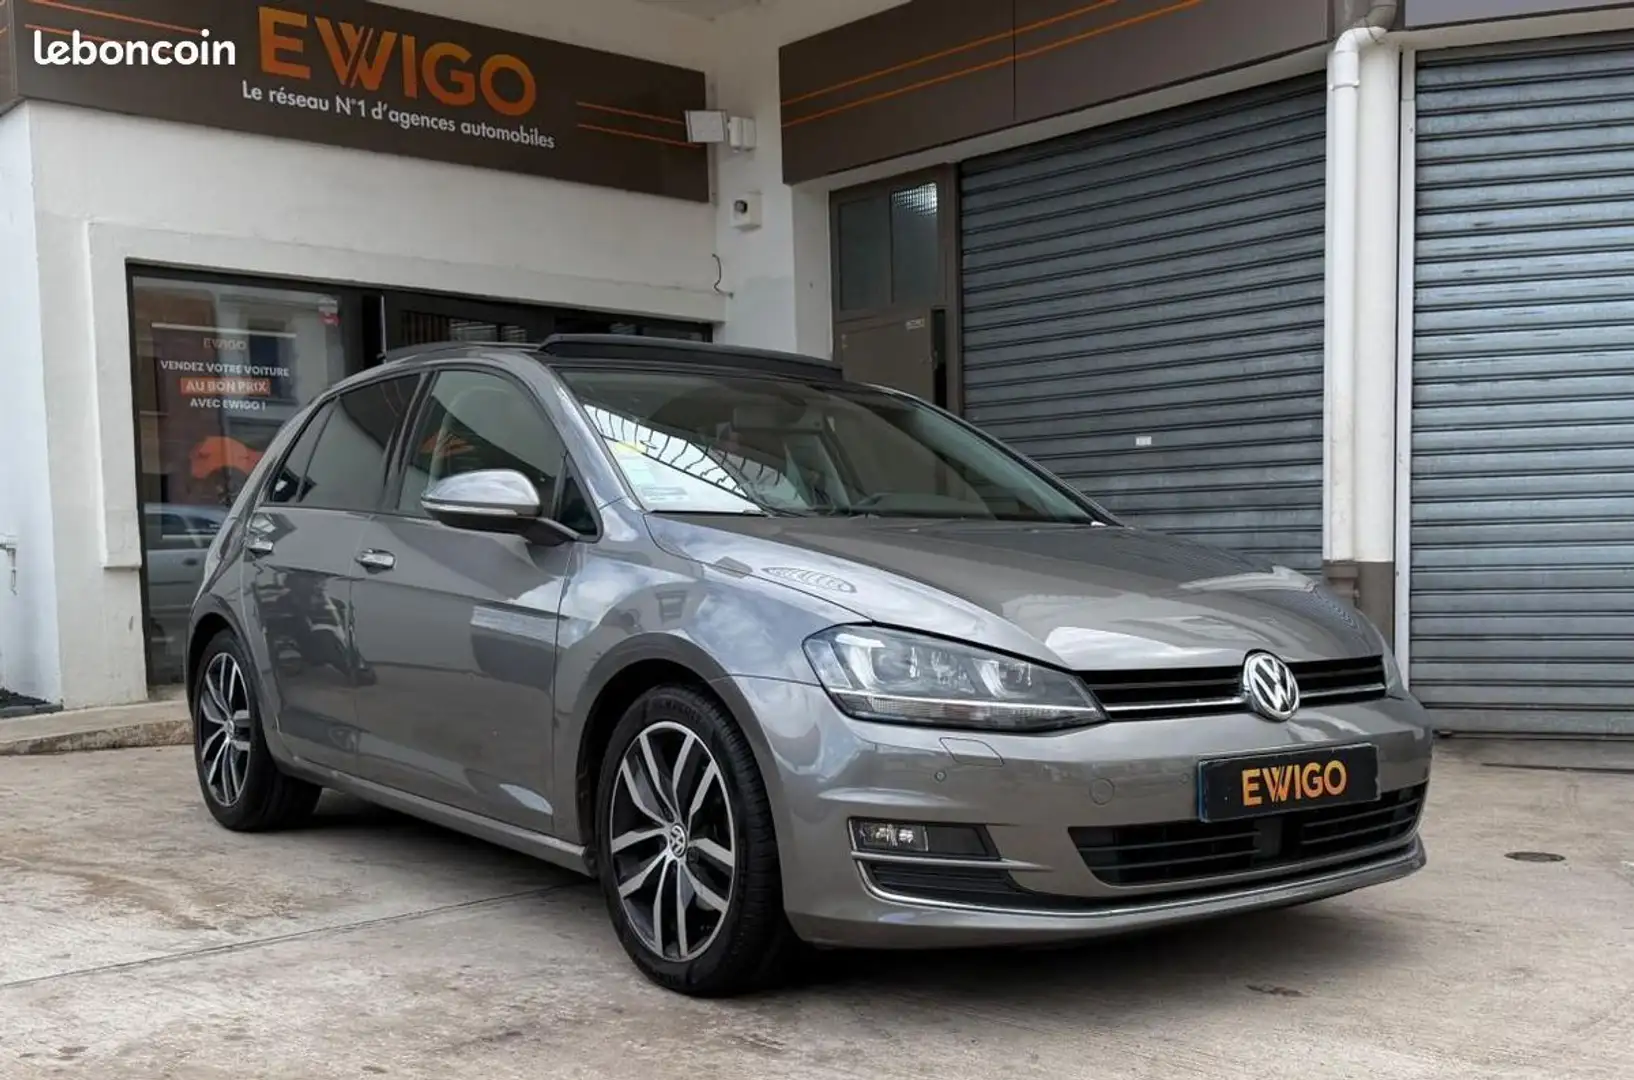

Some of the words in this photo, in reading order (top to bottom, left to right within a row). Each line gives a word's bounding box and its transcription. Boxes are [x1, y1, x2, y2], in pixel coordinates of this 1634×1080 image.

[258, 6, 537, 116] EWIGO
[242, 80, 262, 101] Le
[268, 86, 329, 111] réseau
[460, 121, 556, 149] automobiles
[160, 359, 205, 372] VENDEZ
[206, 362, 242, 375] VOTRE
[244, 365, 290, 377] VOITURE
[186, 380, 205, 393] AU
[208, 381, 236, 393] BON
[239, 382, 267, 393] PRIX
[190, 397, 221, 409] AVEC
[1242, 760, 1347, 806] EWIGO
